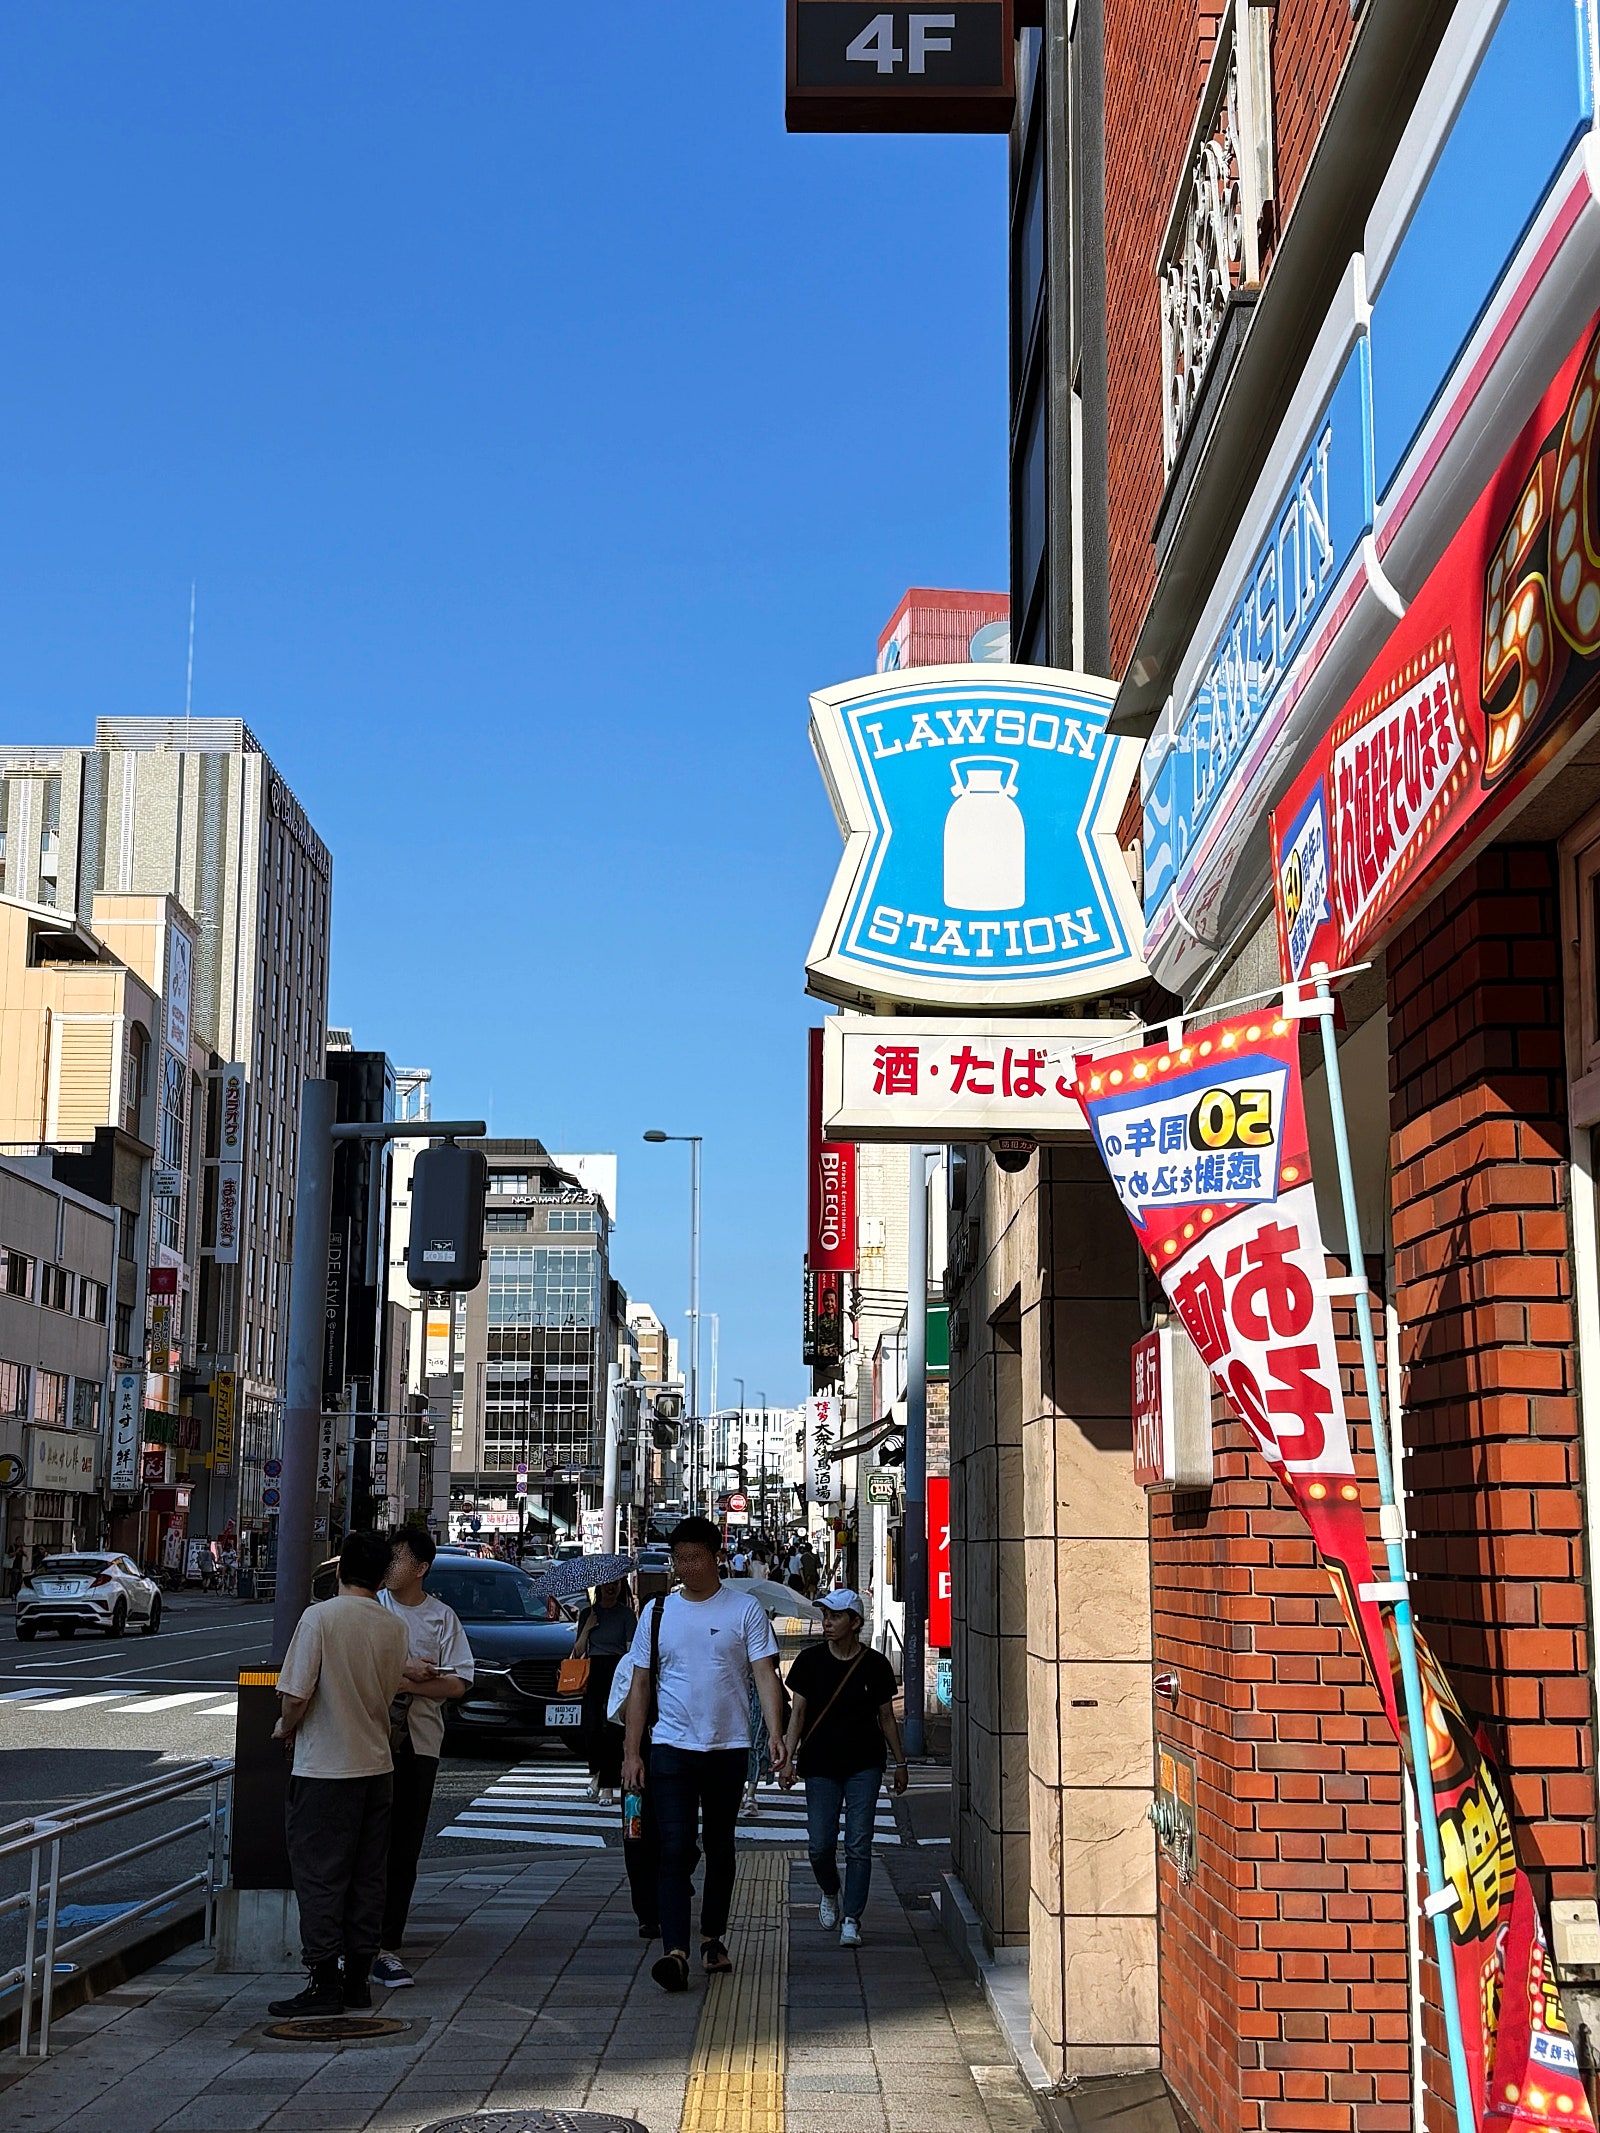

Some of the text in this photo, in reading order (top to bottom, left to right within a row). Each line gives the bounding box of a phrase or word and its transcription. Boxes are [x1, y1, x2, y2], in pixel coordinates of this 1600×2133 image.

[846, 14, 955, 73] 4F
[1190, 425, 1334, 829] LAWSON
[866, 708, 1105, 761] LAWSON
[1339, 680, 1454, 923] お値段そのまま
[868, 905, 1100, 957] STATION
[225, 1087, 240, 1135] カラオケ
[820, 1152, 840, 1190] BIG
[219, 1178, 237, 1248] まねきねこ
[820, 1193, 840, 1250] ECHO
[1136, 1346, 1156, 1405] 銀行
[1136, 1410, 1160, 1470] ATM
